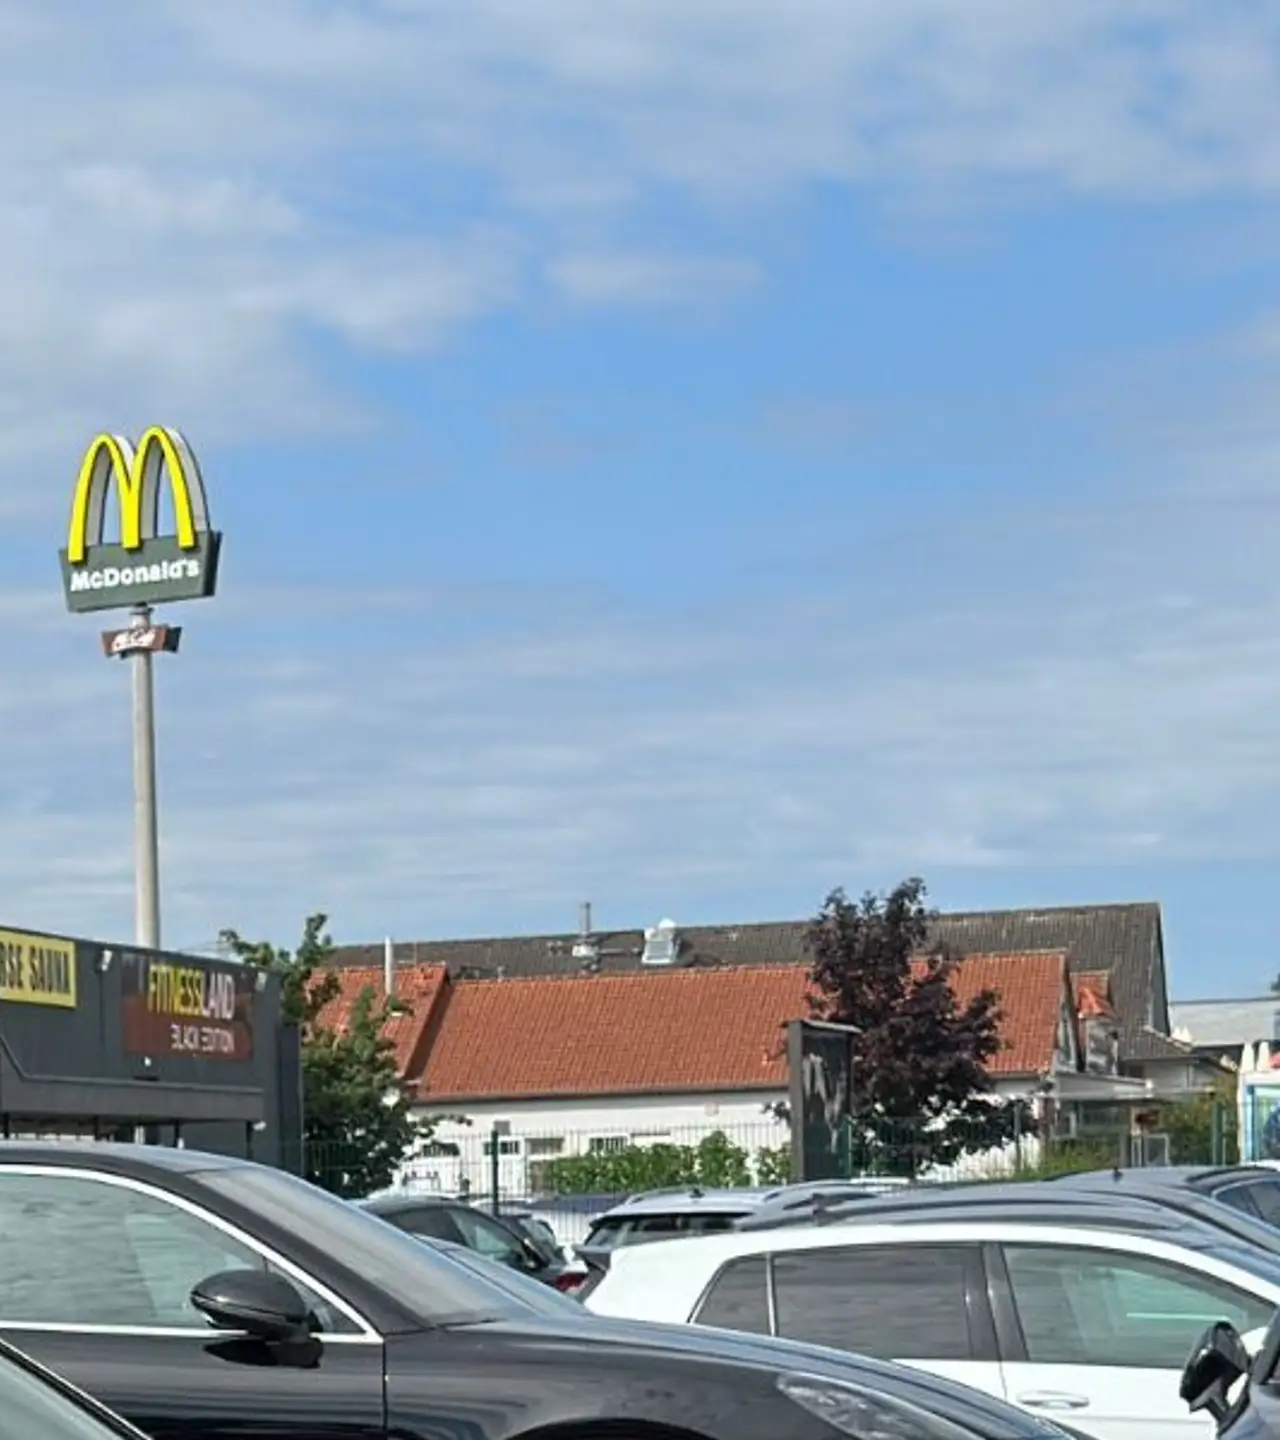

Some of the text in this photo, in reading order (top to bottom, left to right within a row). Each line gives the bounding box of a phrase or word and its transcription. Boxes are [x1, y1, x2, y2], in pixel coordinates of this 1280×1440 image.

[70, 558, 200, 592] McDonald's
[30, 945, 71, 995] SAUNA
[148, 963, 236, 1021] FITNESSLAND
